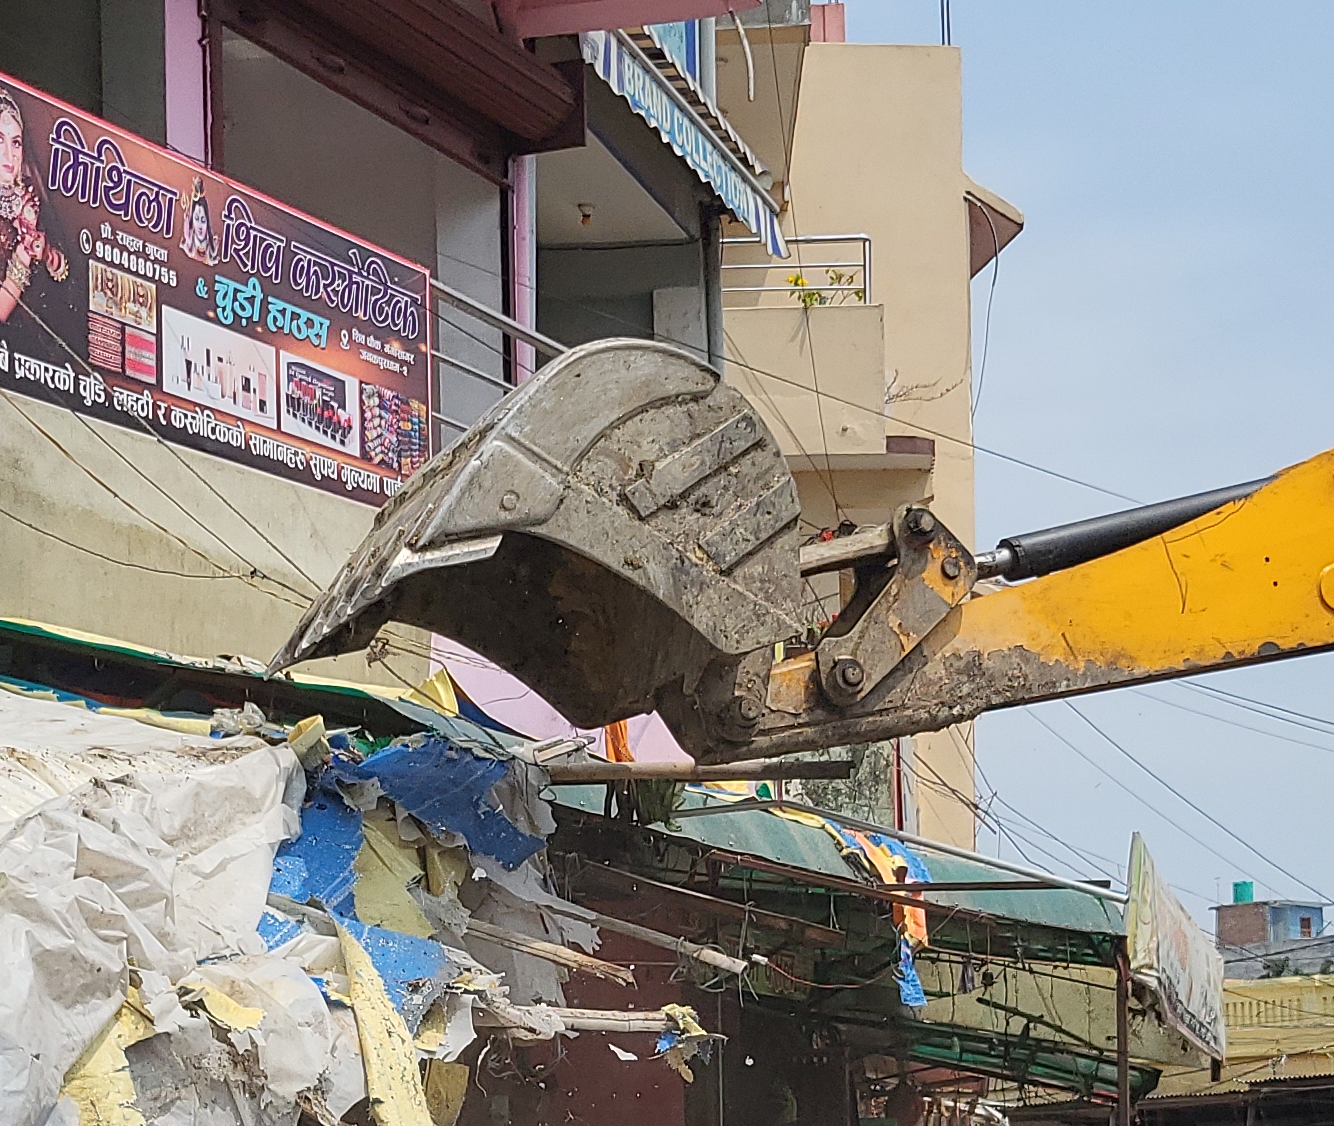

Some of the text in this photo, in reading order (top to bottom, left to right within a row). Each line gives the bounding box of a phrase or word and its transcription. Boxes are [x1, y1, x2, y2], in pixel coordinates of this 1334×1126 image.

[622, 54, 750, 222] BRAND COLLECTION
[48, 118, 180, 238] मिथिला
[222, 195, 286, 284] शिव
[116, 230, 143, 252] राहुल
[145, 242, 168, 262] गुप्ता
[95, 241, 177, 287] 9804880755
[196, 277, 208, 298] &
[267, 296, 330, 348] हाउस
[14, 352, 75, 394] प्रकारको
[113, 386, 153, 420] लहठी
[156, 401, 167, 425] र
[170, 407, 246, 450] कस्मेटिकको
[309, 452, 338, 481] सुपथ
[340, 463, 381, 494] मुल्यमा
